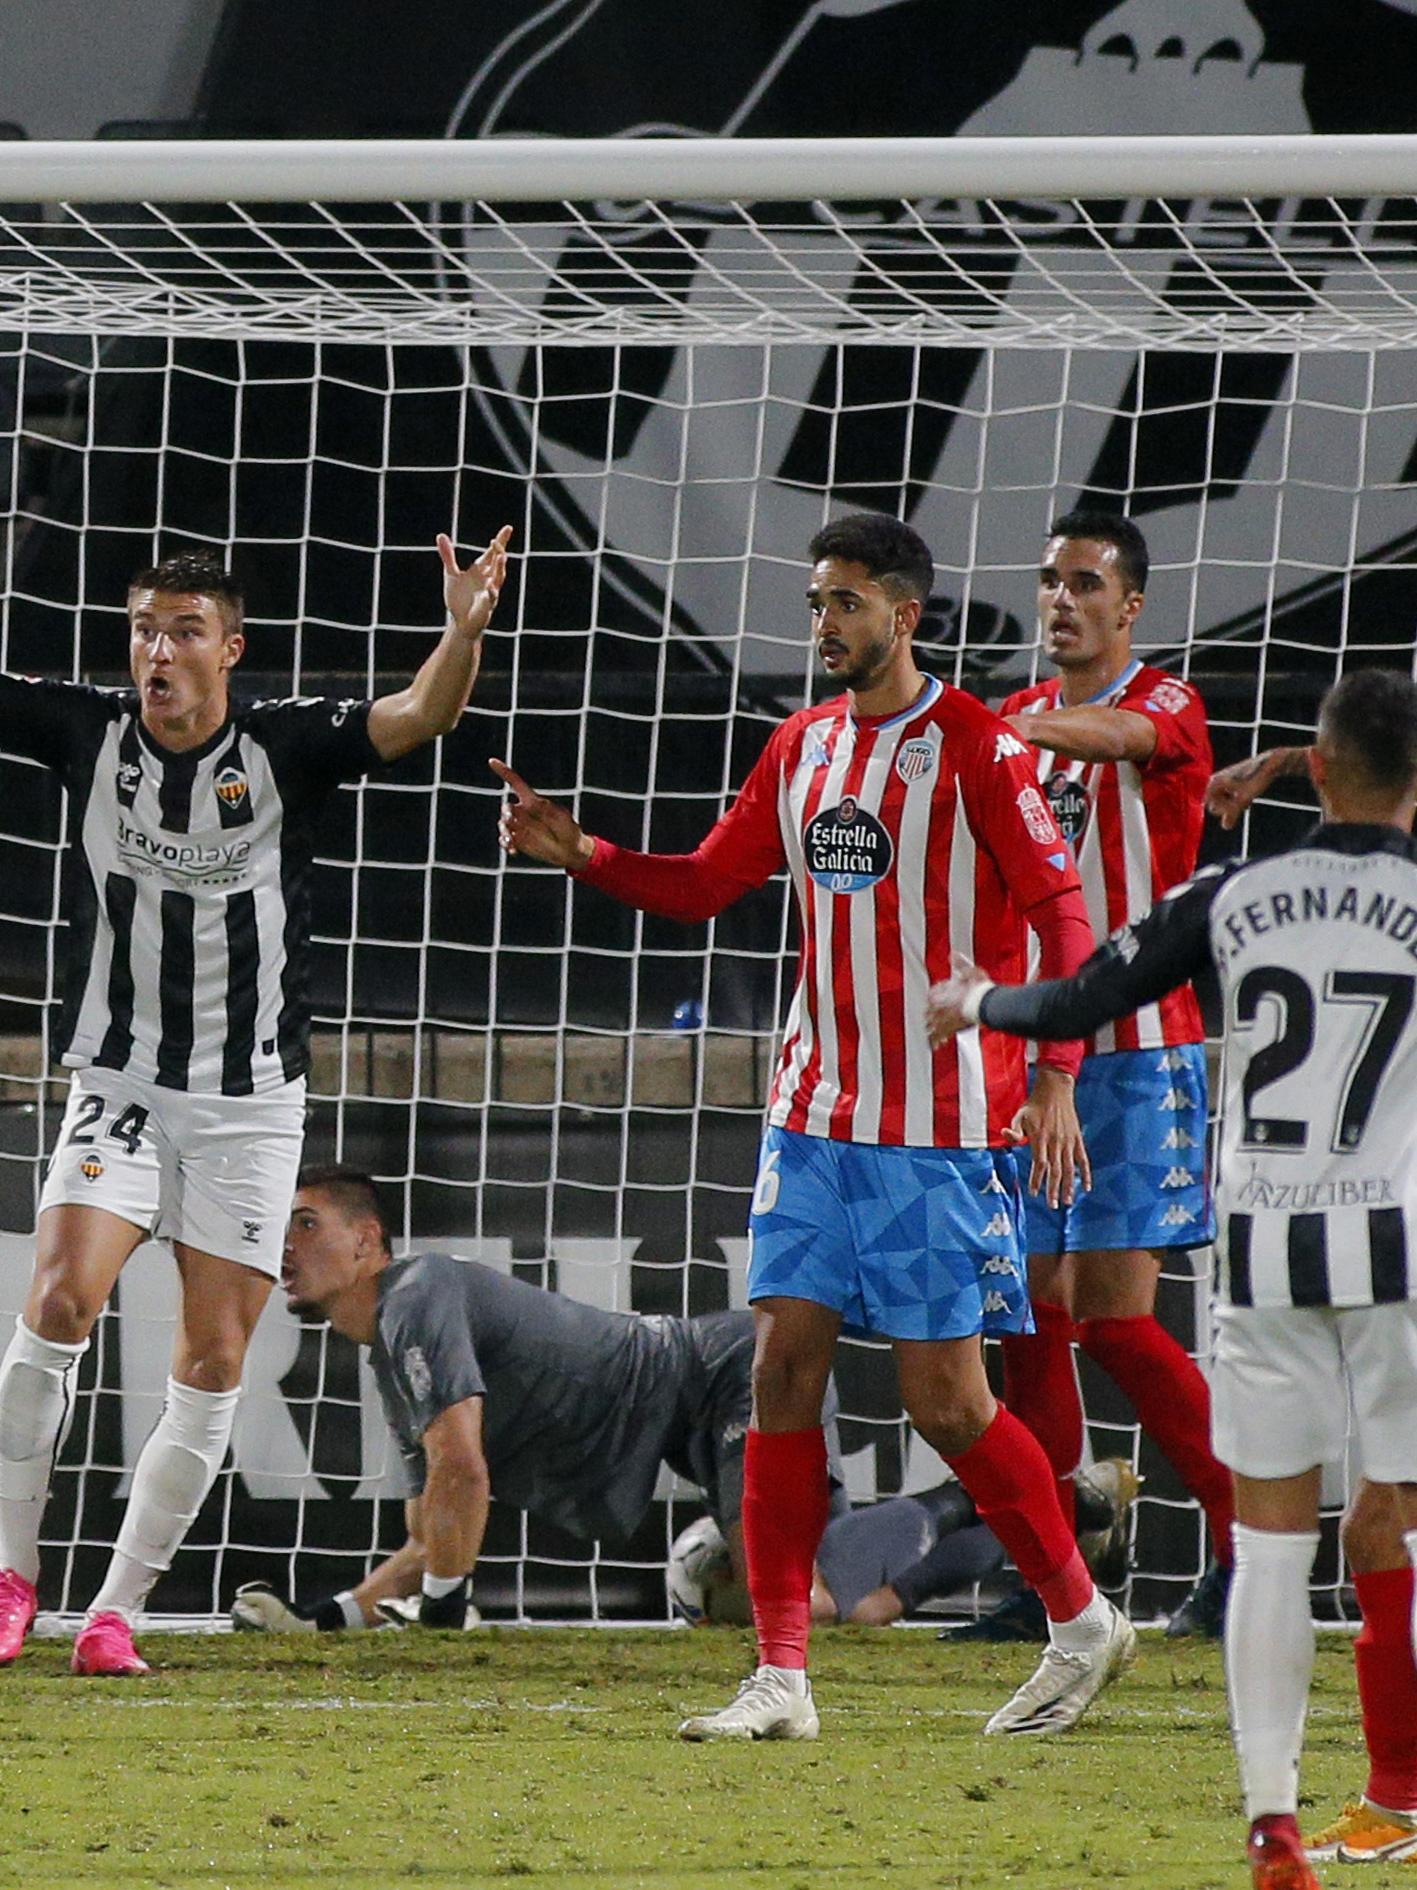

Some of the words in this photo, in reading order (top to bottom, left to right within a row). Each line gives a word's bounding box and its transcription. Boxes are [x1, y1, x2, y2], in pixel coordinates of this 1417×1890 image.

[811, 822, 877, 849] Estrella
[813, 846, 873, 872] Galicia
[1232, 966, 1417, 1154] 27
[67, 1094, 150, 1155] 24
[751, 1150, 781, 1215] 6
